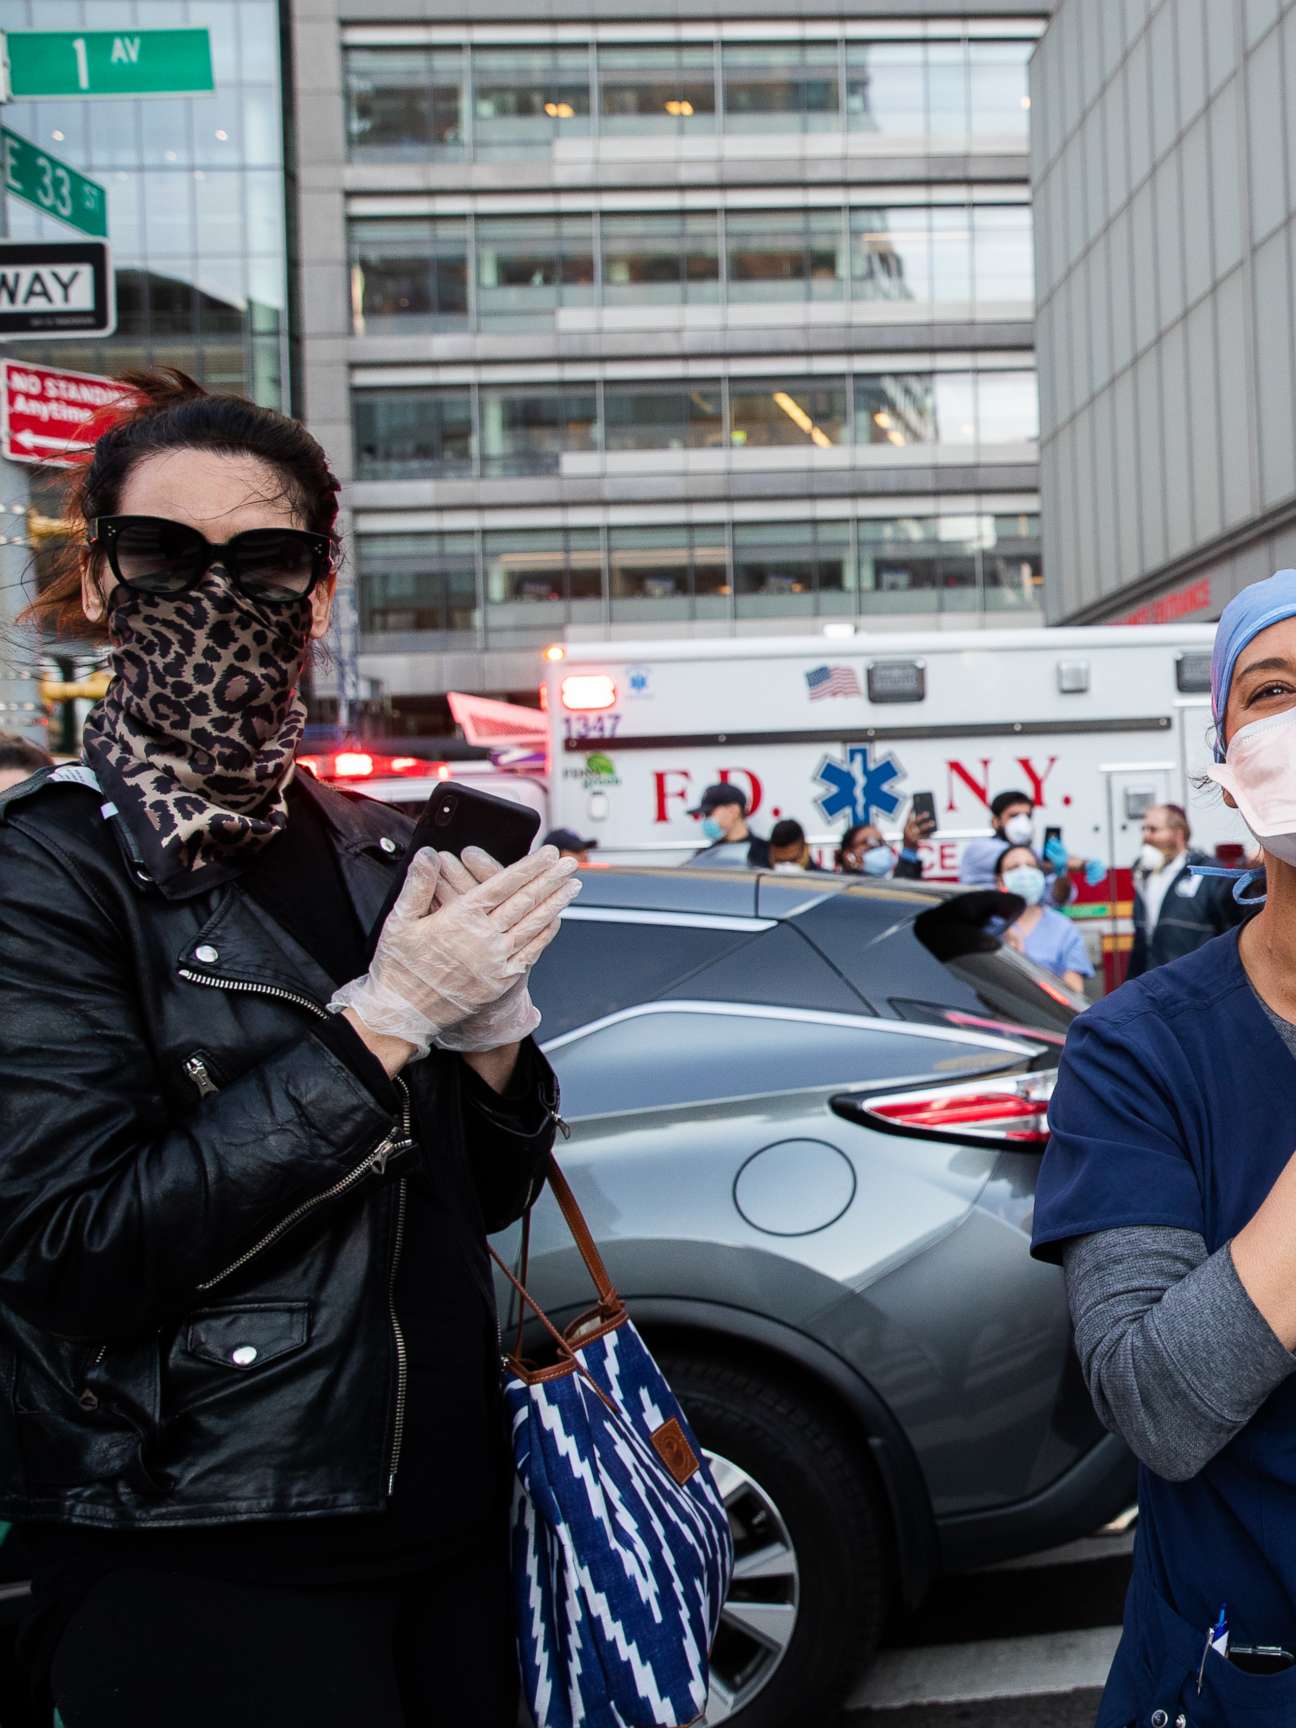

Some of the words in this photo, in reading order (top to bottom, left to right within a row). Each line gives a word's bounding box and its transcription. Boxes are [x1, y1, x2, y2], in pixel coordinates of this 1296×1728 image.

[73, 37, 89, 90] 1
[110, 36, 141, 64] AV
[37, 156, 73, 218] 33
[9, 369, 42, 396] NO
[13, 394, 94, 423] Anytime
